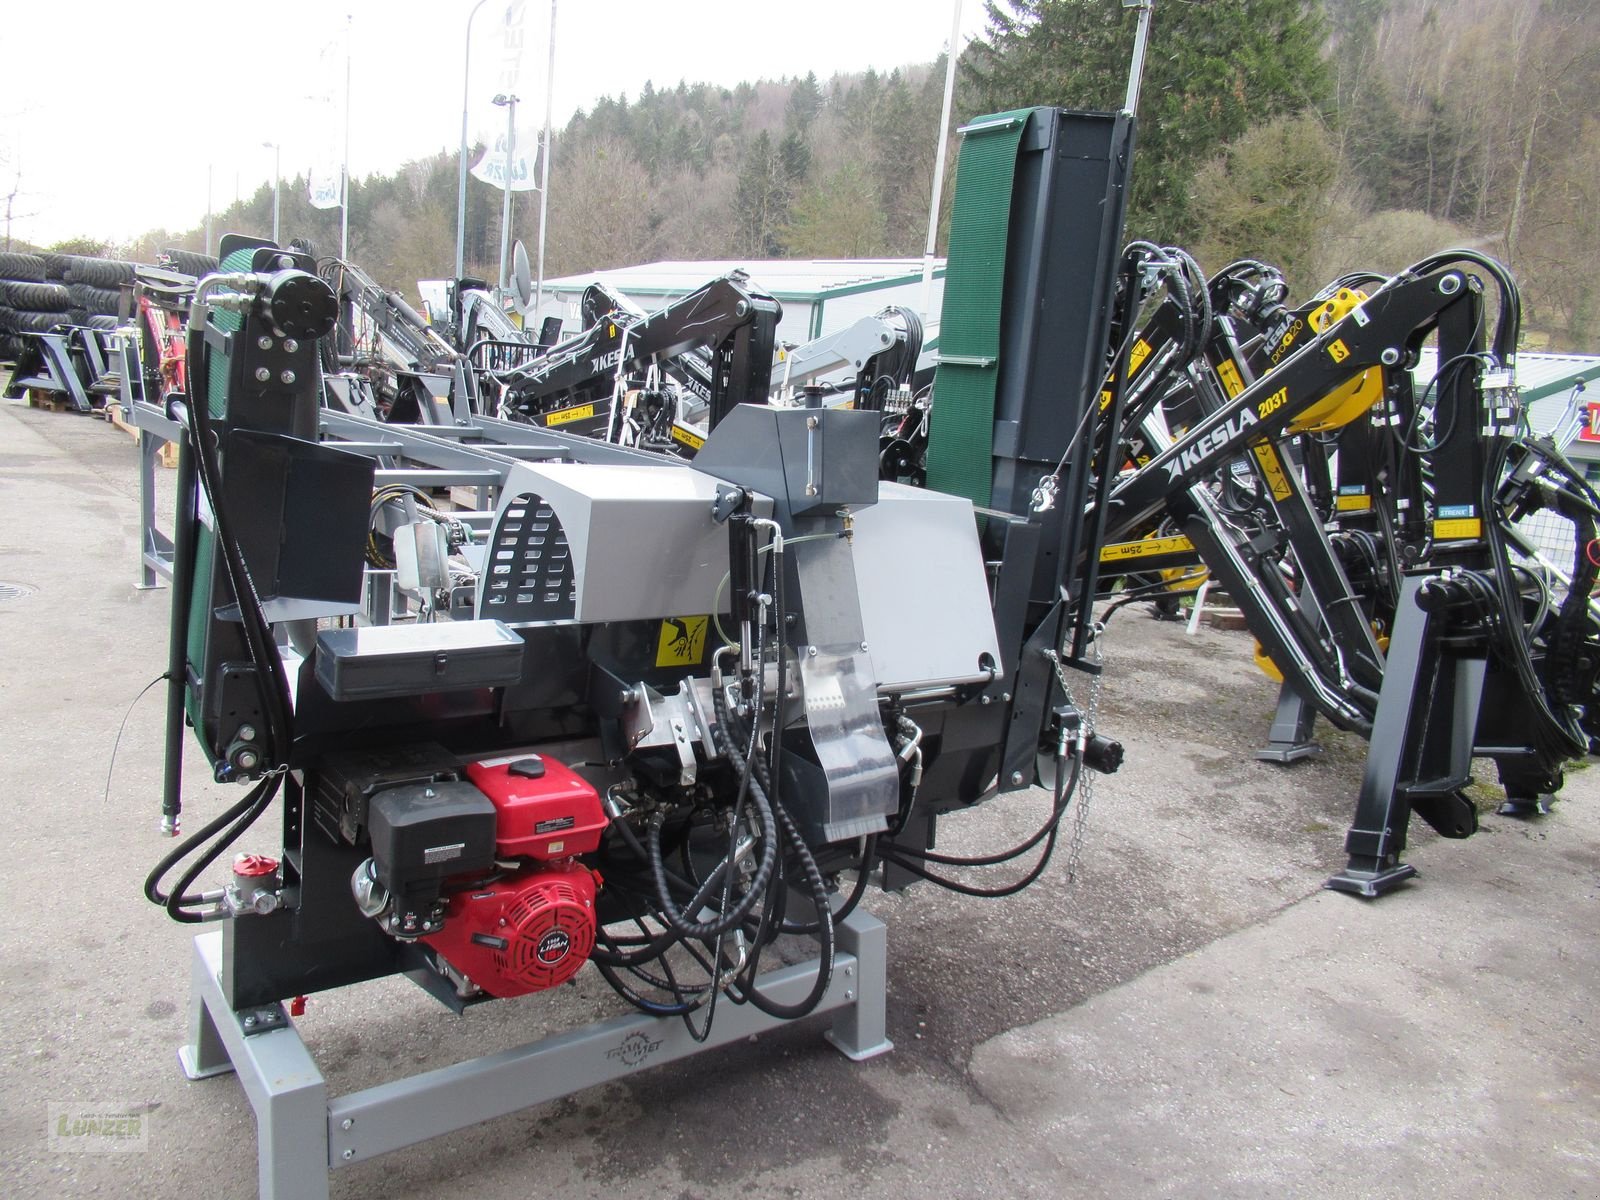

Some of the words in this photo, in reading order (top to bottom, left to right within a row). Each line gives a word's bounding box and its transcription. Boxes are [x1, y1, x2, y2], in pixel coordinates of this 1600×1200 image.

[1263, 312, 1297, 356] KESLA
[1271, 319, 1303, 364] proG20
[1181, 407, 1259, 472] KESLA
[1258, 387, 1288, 420] 203T
[1121, 545, 1142, 554] 25m
